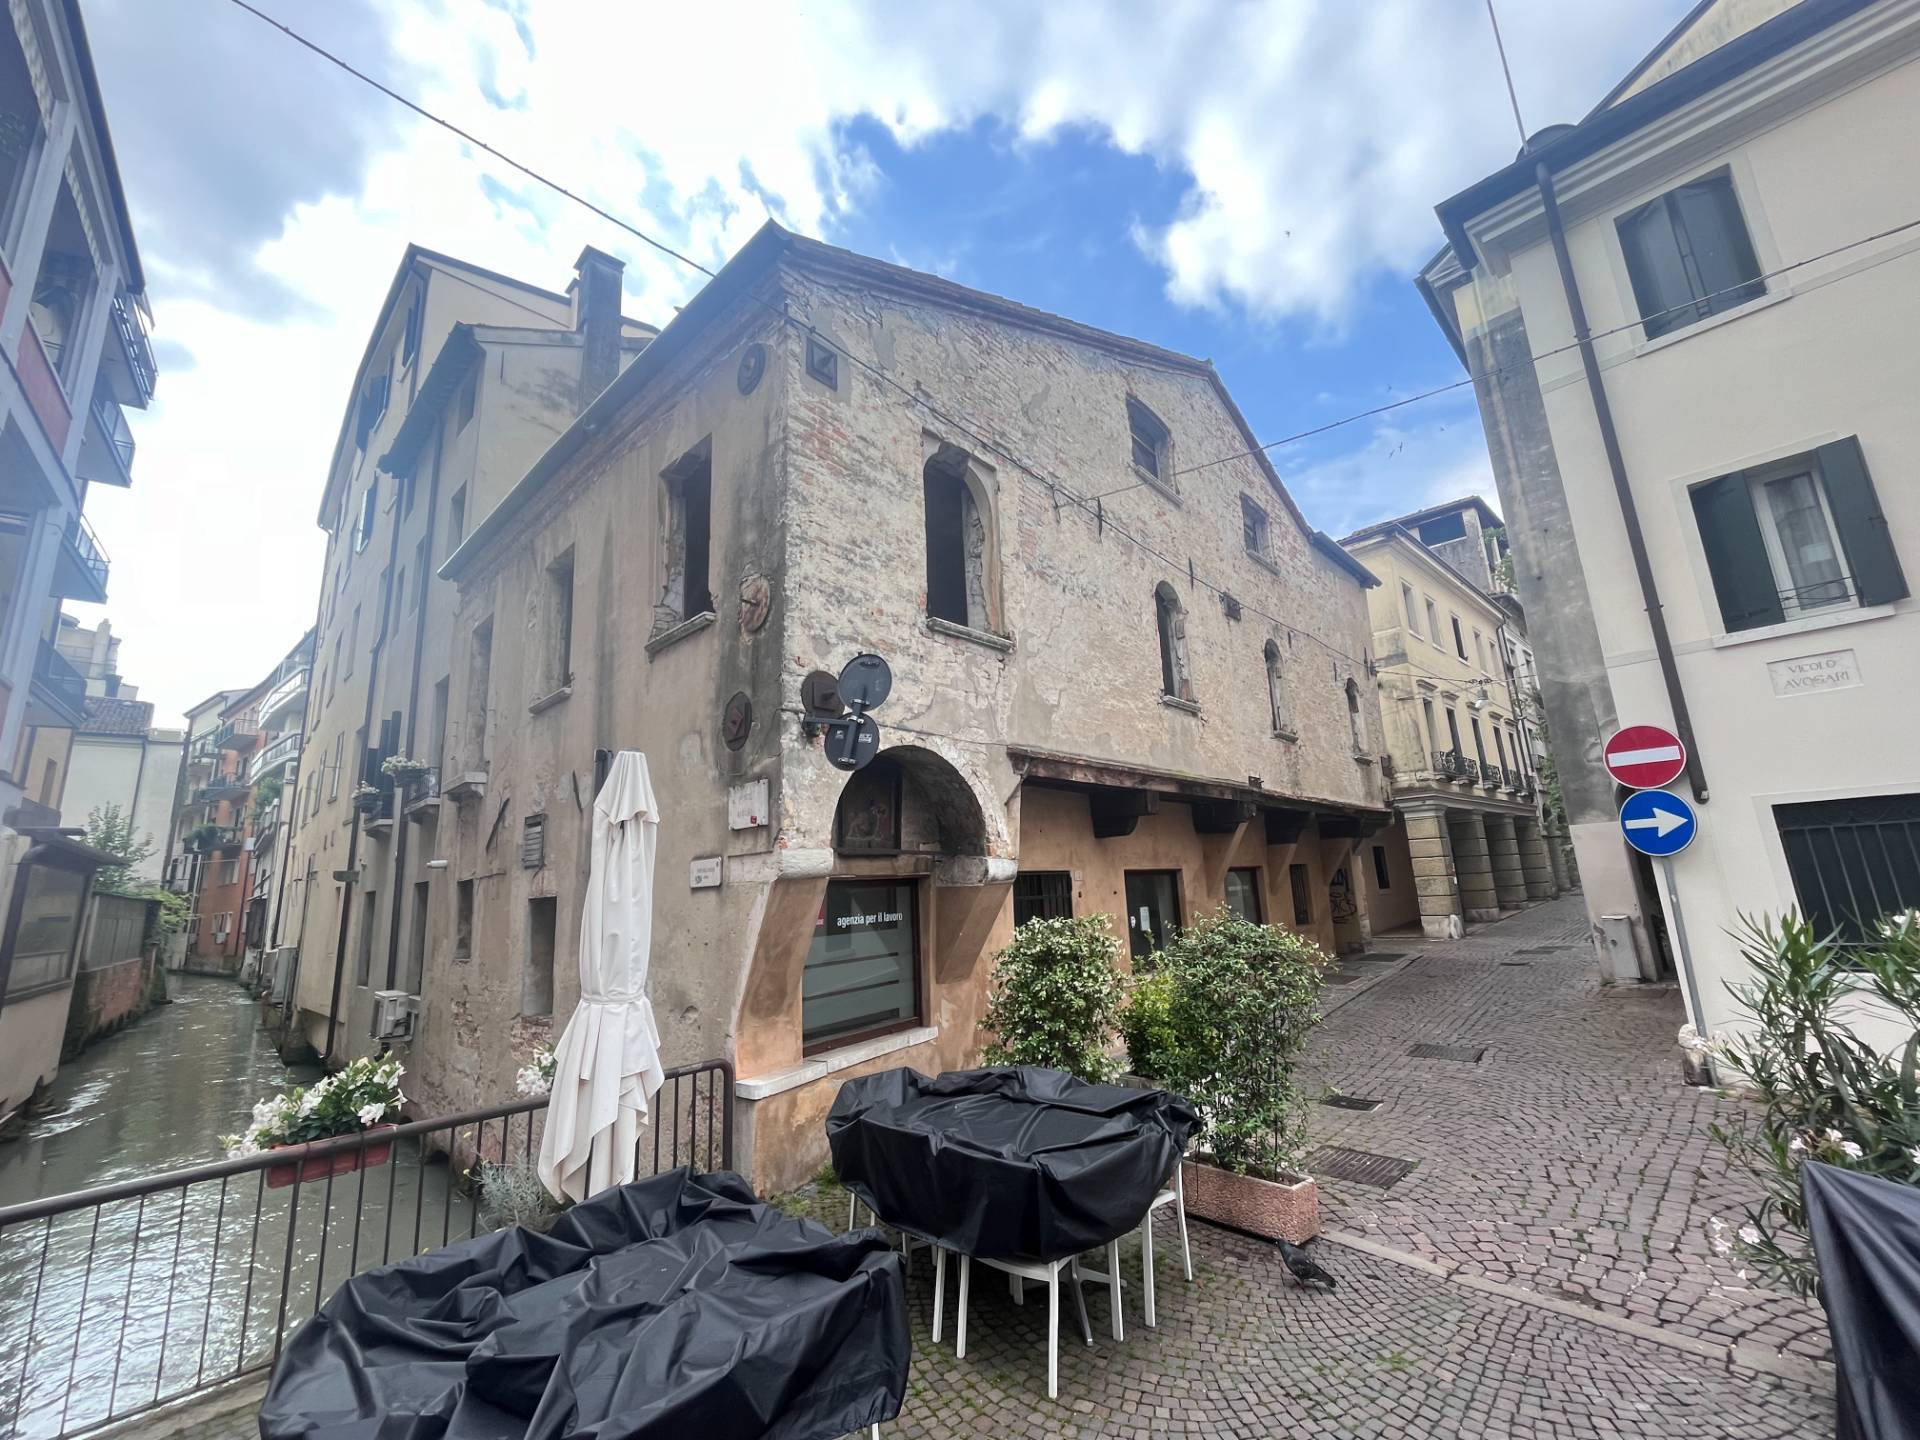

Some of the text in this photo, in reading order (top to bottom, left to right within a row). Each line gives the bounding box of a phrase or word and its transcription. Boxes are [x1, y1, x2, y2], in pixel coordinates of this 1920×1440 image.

[1788, 660, 1837, 673] VICOLO
[837, 914, 864, 928] agenzia
[865, 914, 877, 926] per
[877, 912, 883, 922] il
[883, 912, 903, 922] lavoro
